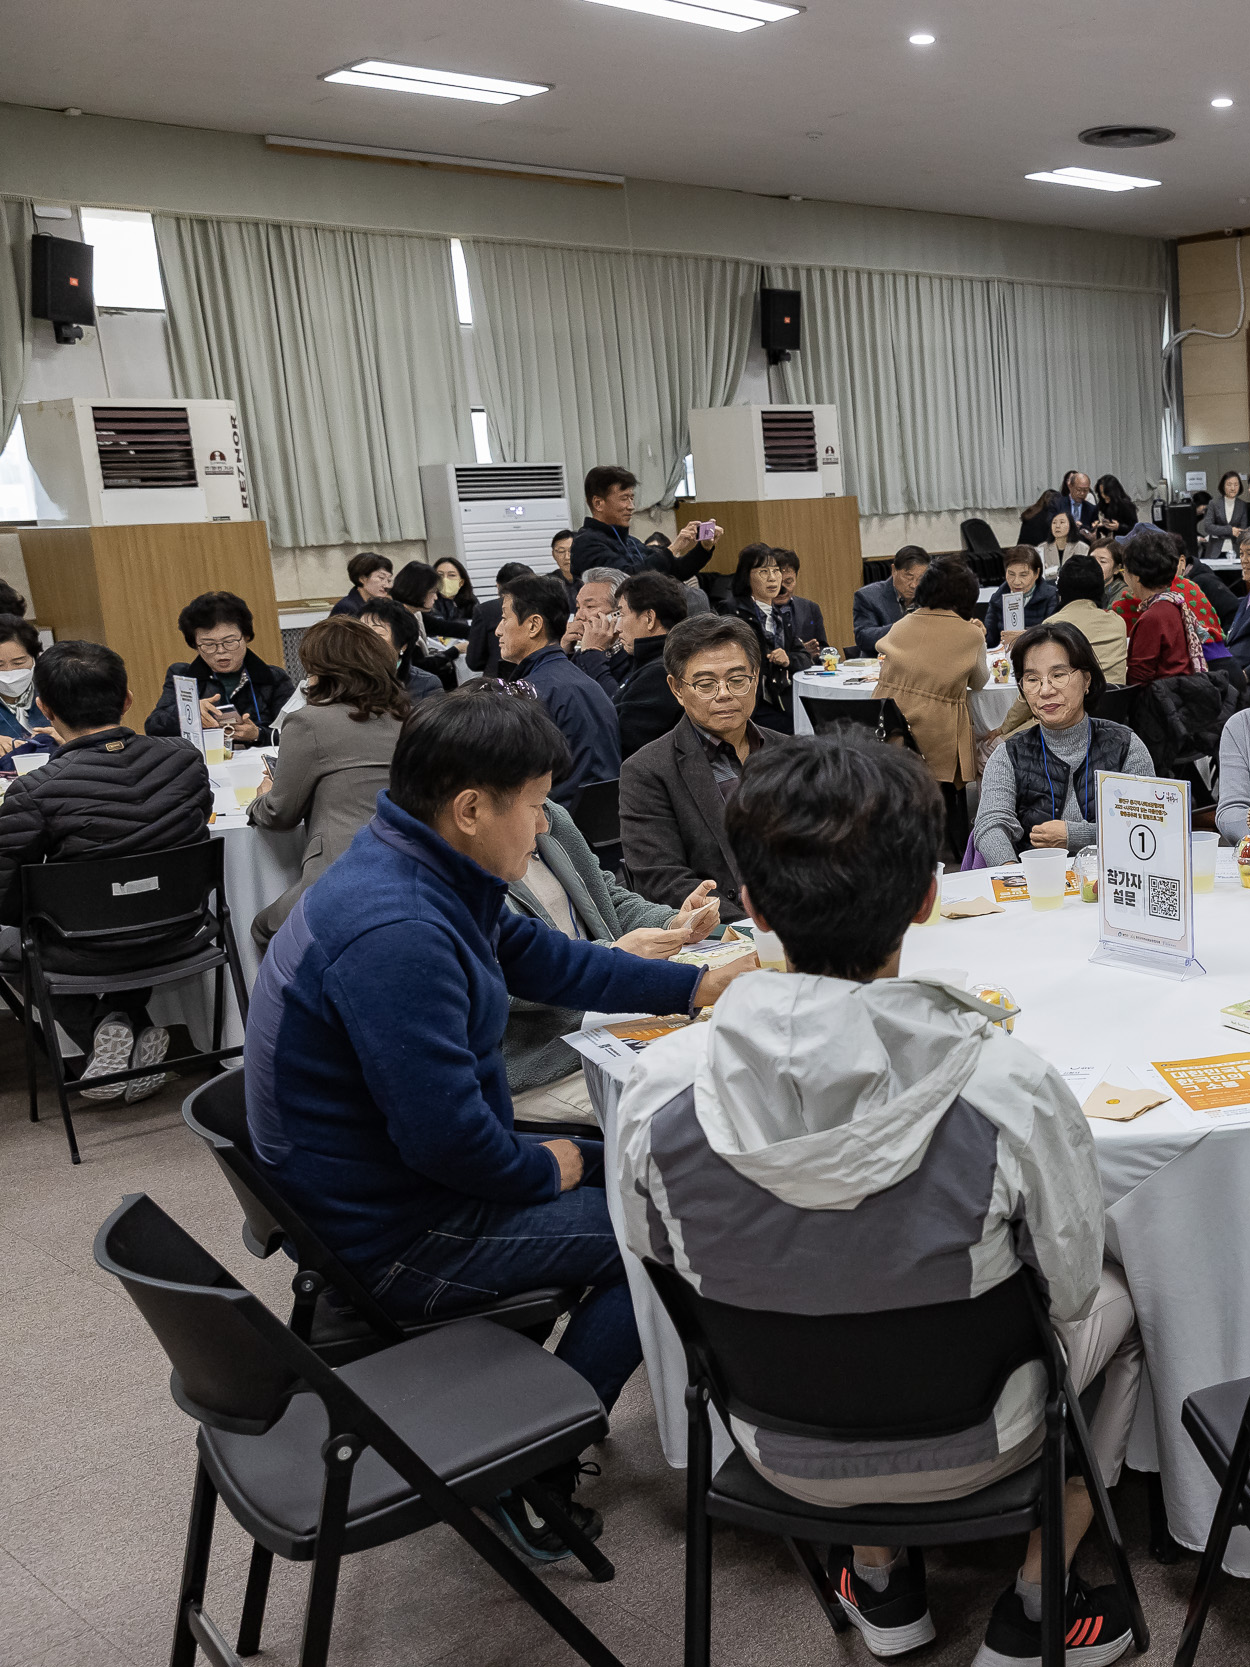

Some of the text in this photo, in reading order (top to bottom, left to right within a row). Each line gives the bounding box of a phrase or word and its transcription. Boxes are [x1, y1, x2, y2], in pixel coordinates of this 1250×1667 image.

[230, 415, 249, 508] REZNOR
[1138, 832, 1146, 853] 1
[1107, 868, 1142, 890] 참가자
[1113, 889, 1136, 907] 설문
[1175, 1073, 1246, 1086] 한국인의
[1182, 1085, 1202, 1093] 그
